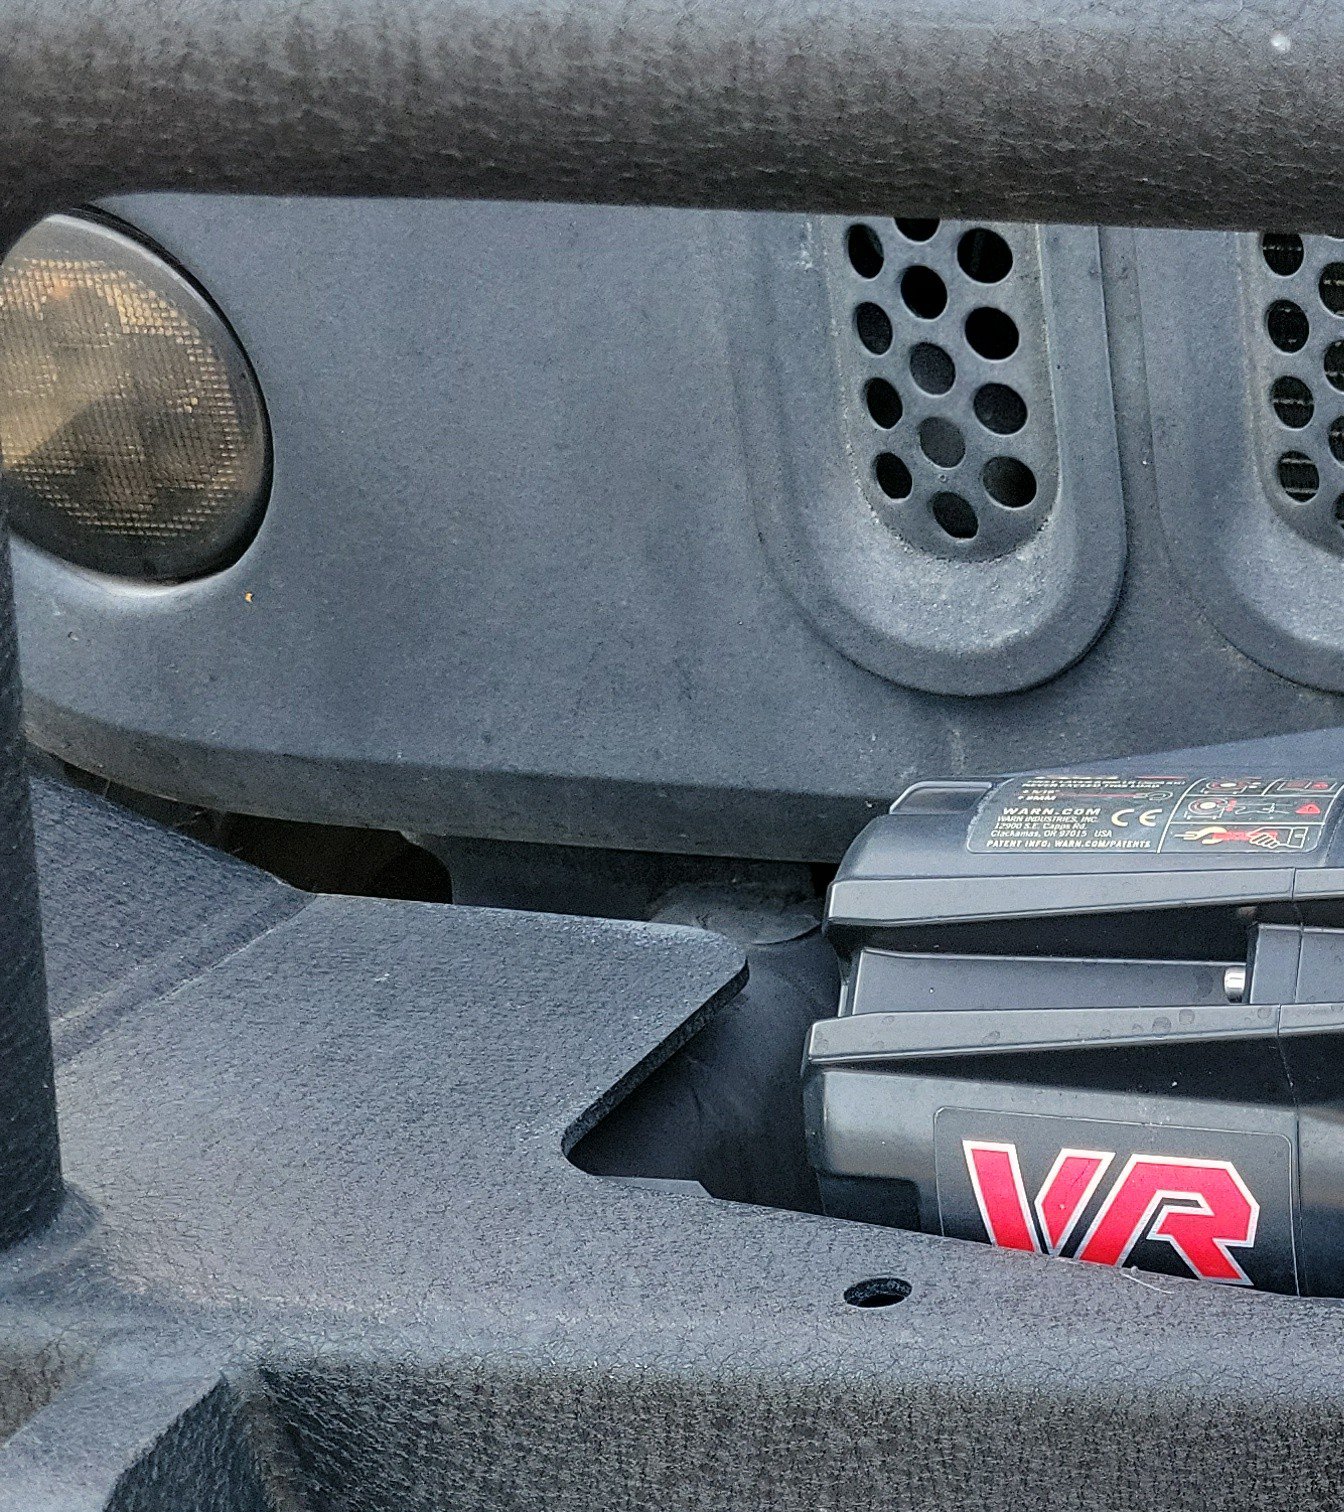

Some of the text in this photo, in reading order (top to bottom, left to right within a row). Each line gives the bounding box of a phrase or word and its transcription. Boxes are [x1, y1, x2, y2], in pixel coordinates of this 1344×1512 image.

[994, 822, 1022, 830] 12900
[1043, 830, 1057, 838] OR
[1058, 830, 1088, 838] 97015
[1094, 830, 1113, 838] USA
[986, 840, 1022, 848] PATENT
[962, 1139, 1260, 1286] VR
